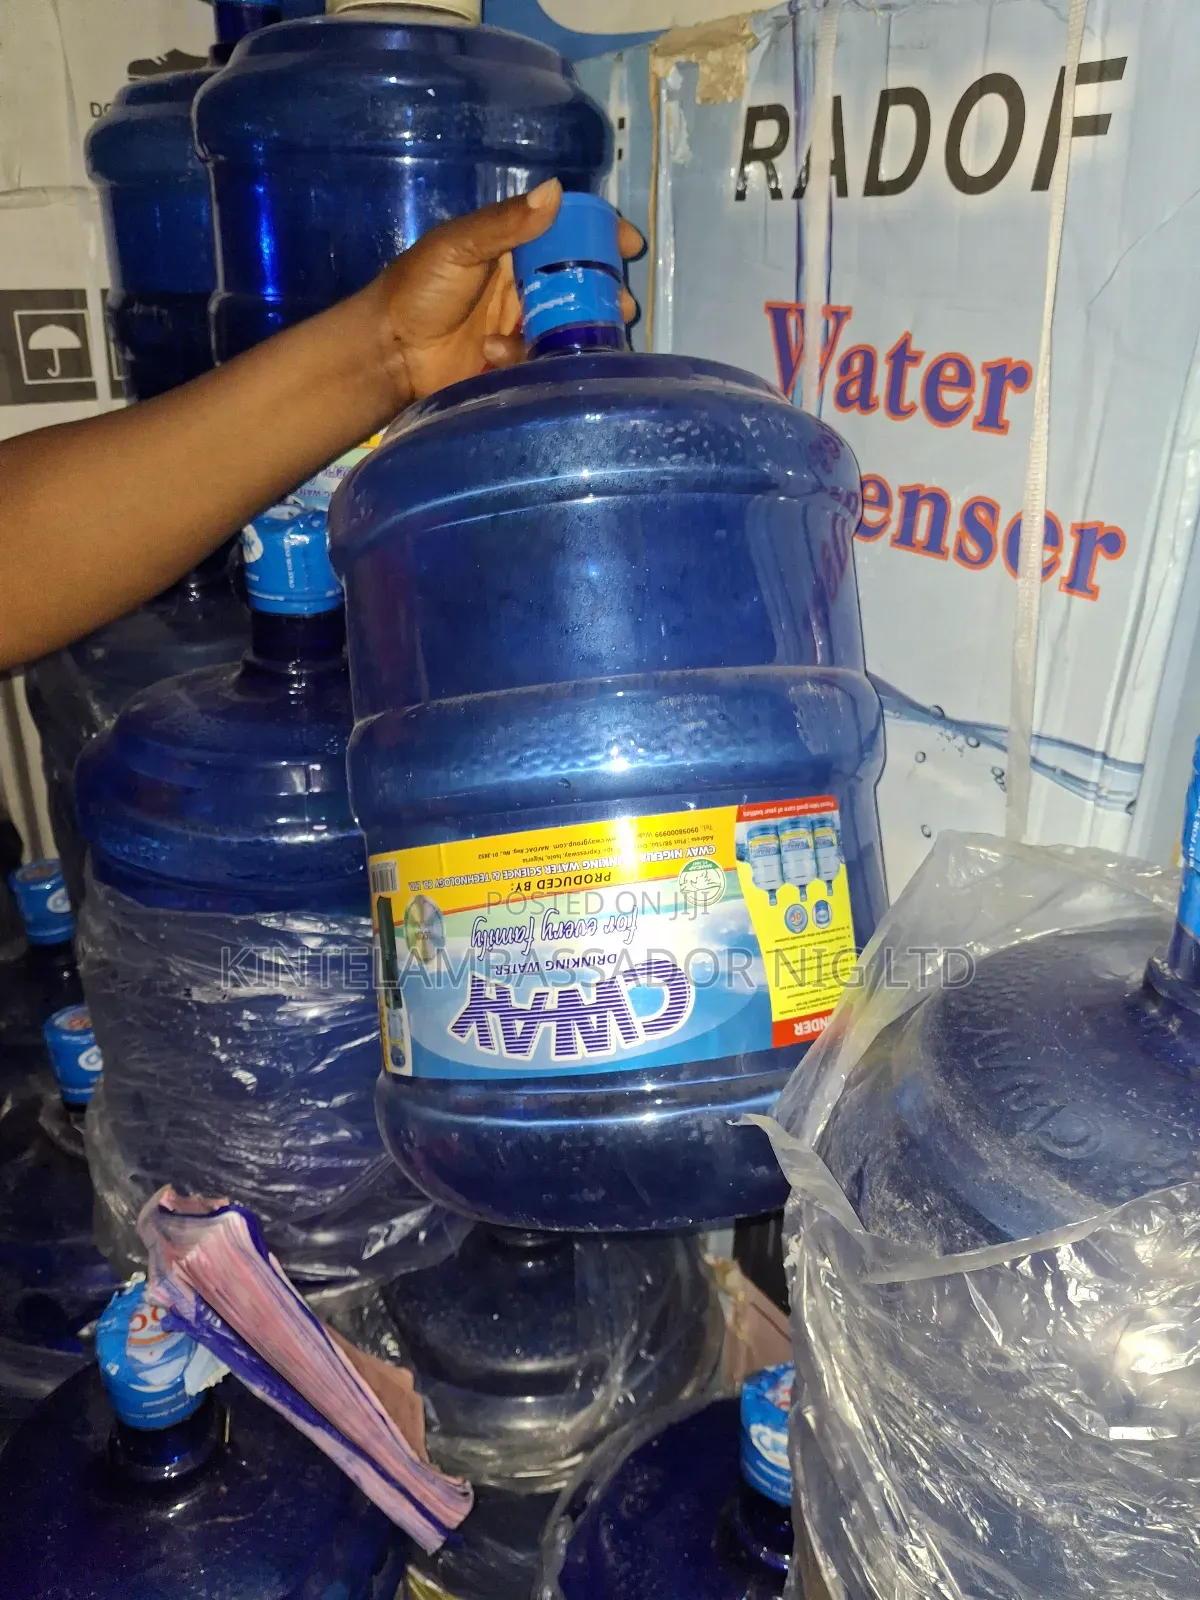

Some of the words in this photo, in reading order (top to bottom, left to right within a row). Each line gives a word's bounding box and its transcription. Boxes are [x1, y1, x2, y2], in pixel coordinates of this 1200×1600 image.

[734, 56, 1129, 202] RADOF
[764, 300, 1034, 437] Water
[851, 472, 1129, 603] enser
[685, 844, 717, 859] CWAY
[502, 866, 542, 880] SCIENCE
[543, 861, 580, 875] WATER
[435, 873, 490, 888] TECHNOLOGY
[509, 880, 533, 893] BY:
[535, 871, 613, 891] PRODUCED
[539, 907, 598, 944] every
[603, 905, 640, 945] for
[470, 915, 535, 961] family
[495, 960, 540, 976] WATER
[544, 953, 618, 971] DRINKING
[447, 959, 695, 1062] CWAY
[793, 1016, 832, 1036] NDER
